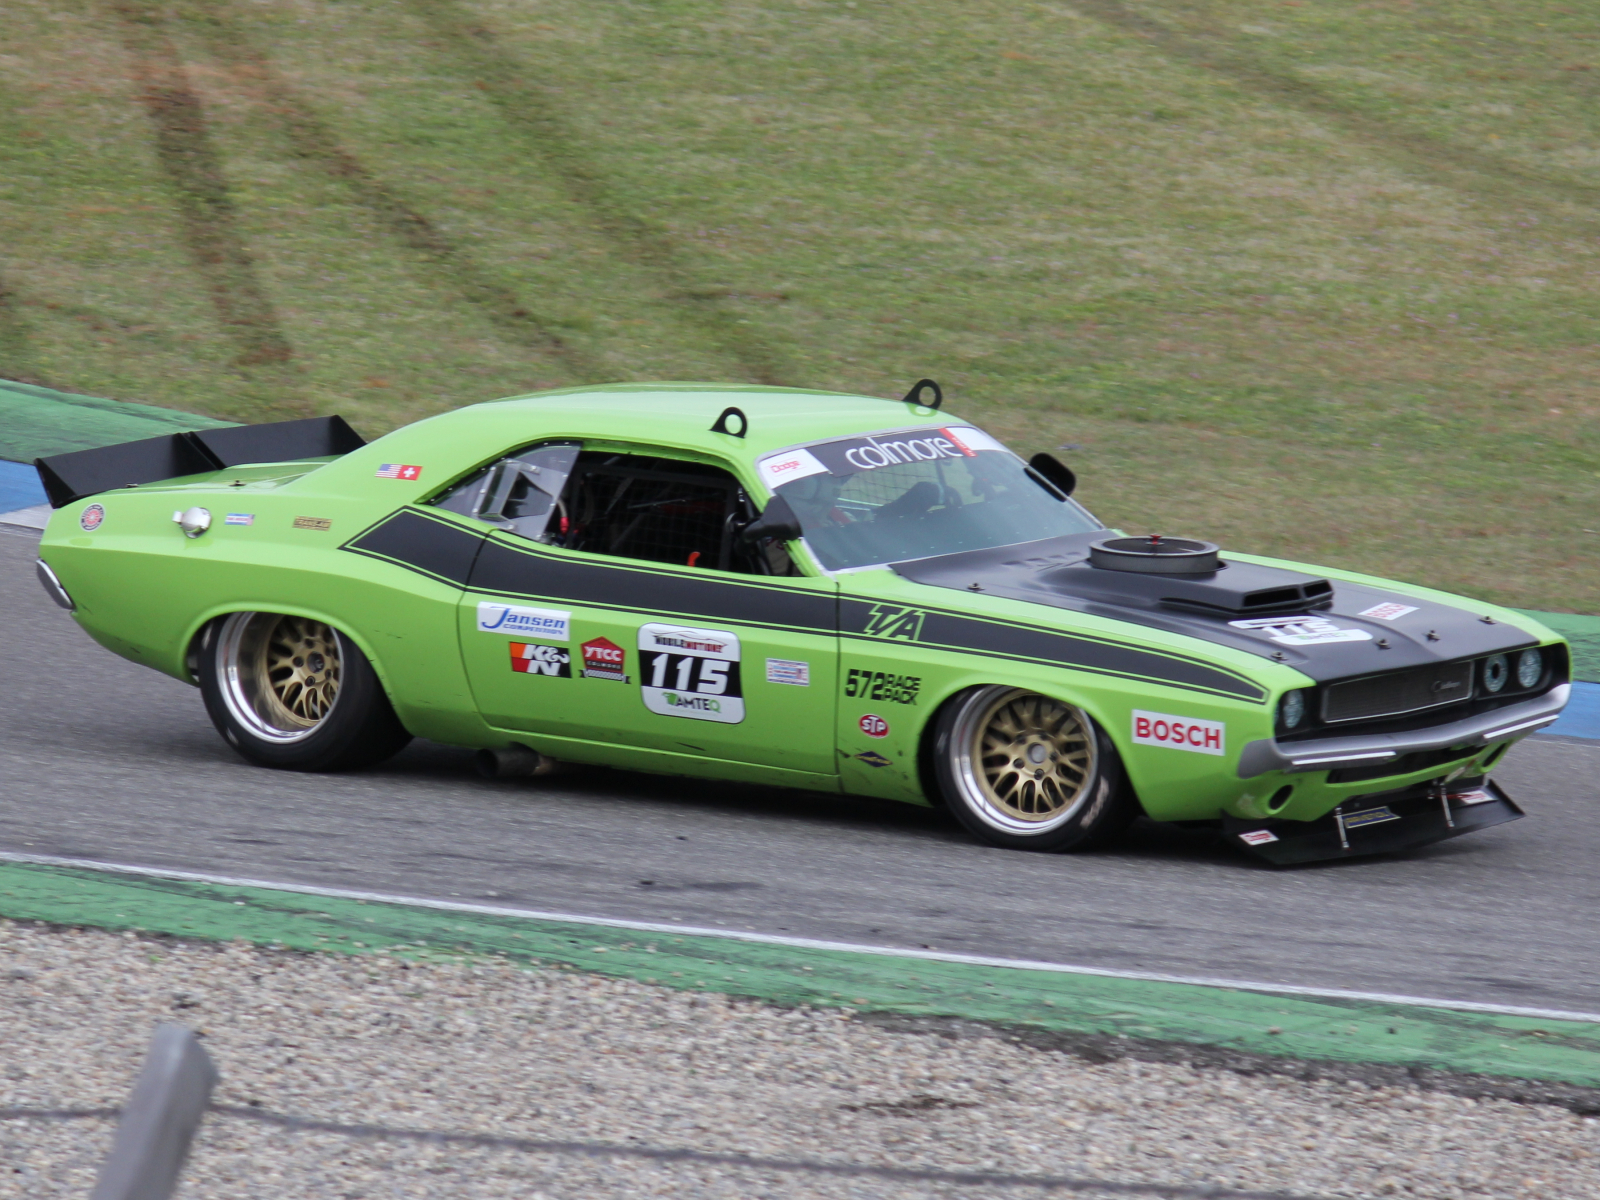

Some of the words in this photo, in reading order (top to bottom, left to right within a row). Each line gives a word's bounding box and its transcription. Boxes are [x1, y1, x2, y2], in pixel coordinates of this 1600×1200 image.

[845, 437, 963, 469] colmore
[770, 460, 800, 473] Dodge
[481, 606, 565, 629] Jansen
[583, 645, 622, 662] YTCC
[652, 653, 730, 695] 115
[845, 668, 886, 701] 572
[885, 674, 921, 692] RACE
[883, 688, 917, 706] PACK
[861, 716, 887, 734] STP
[1135, 716, 1221, 750] BOSCH
